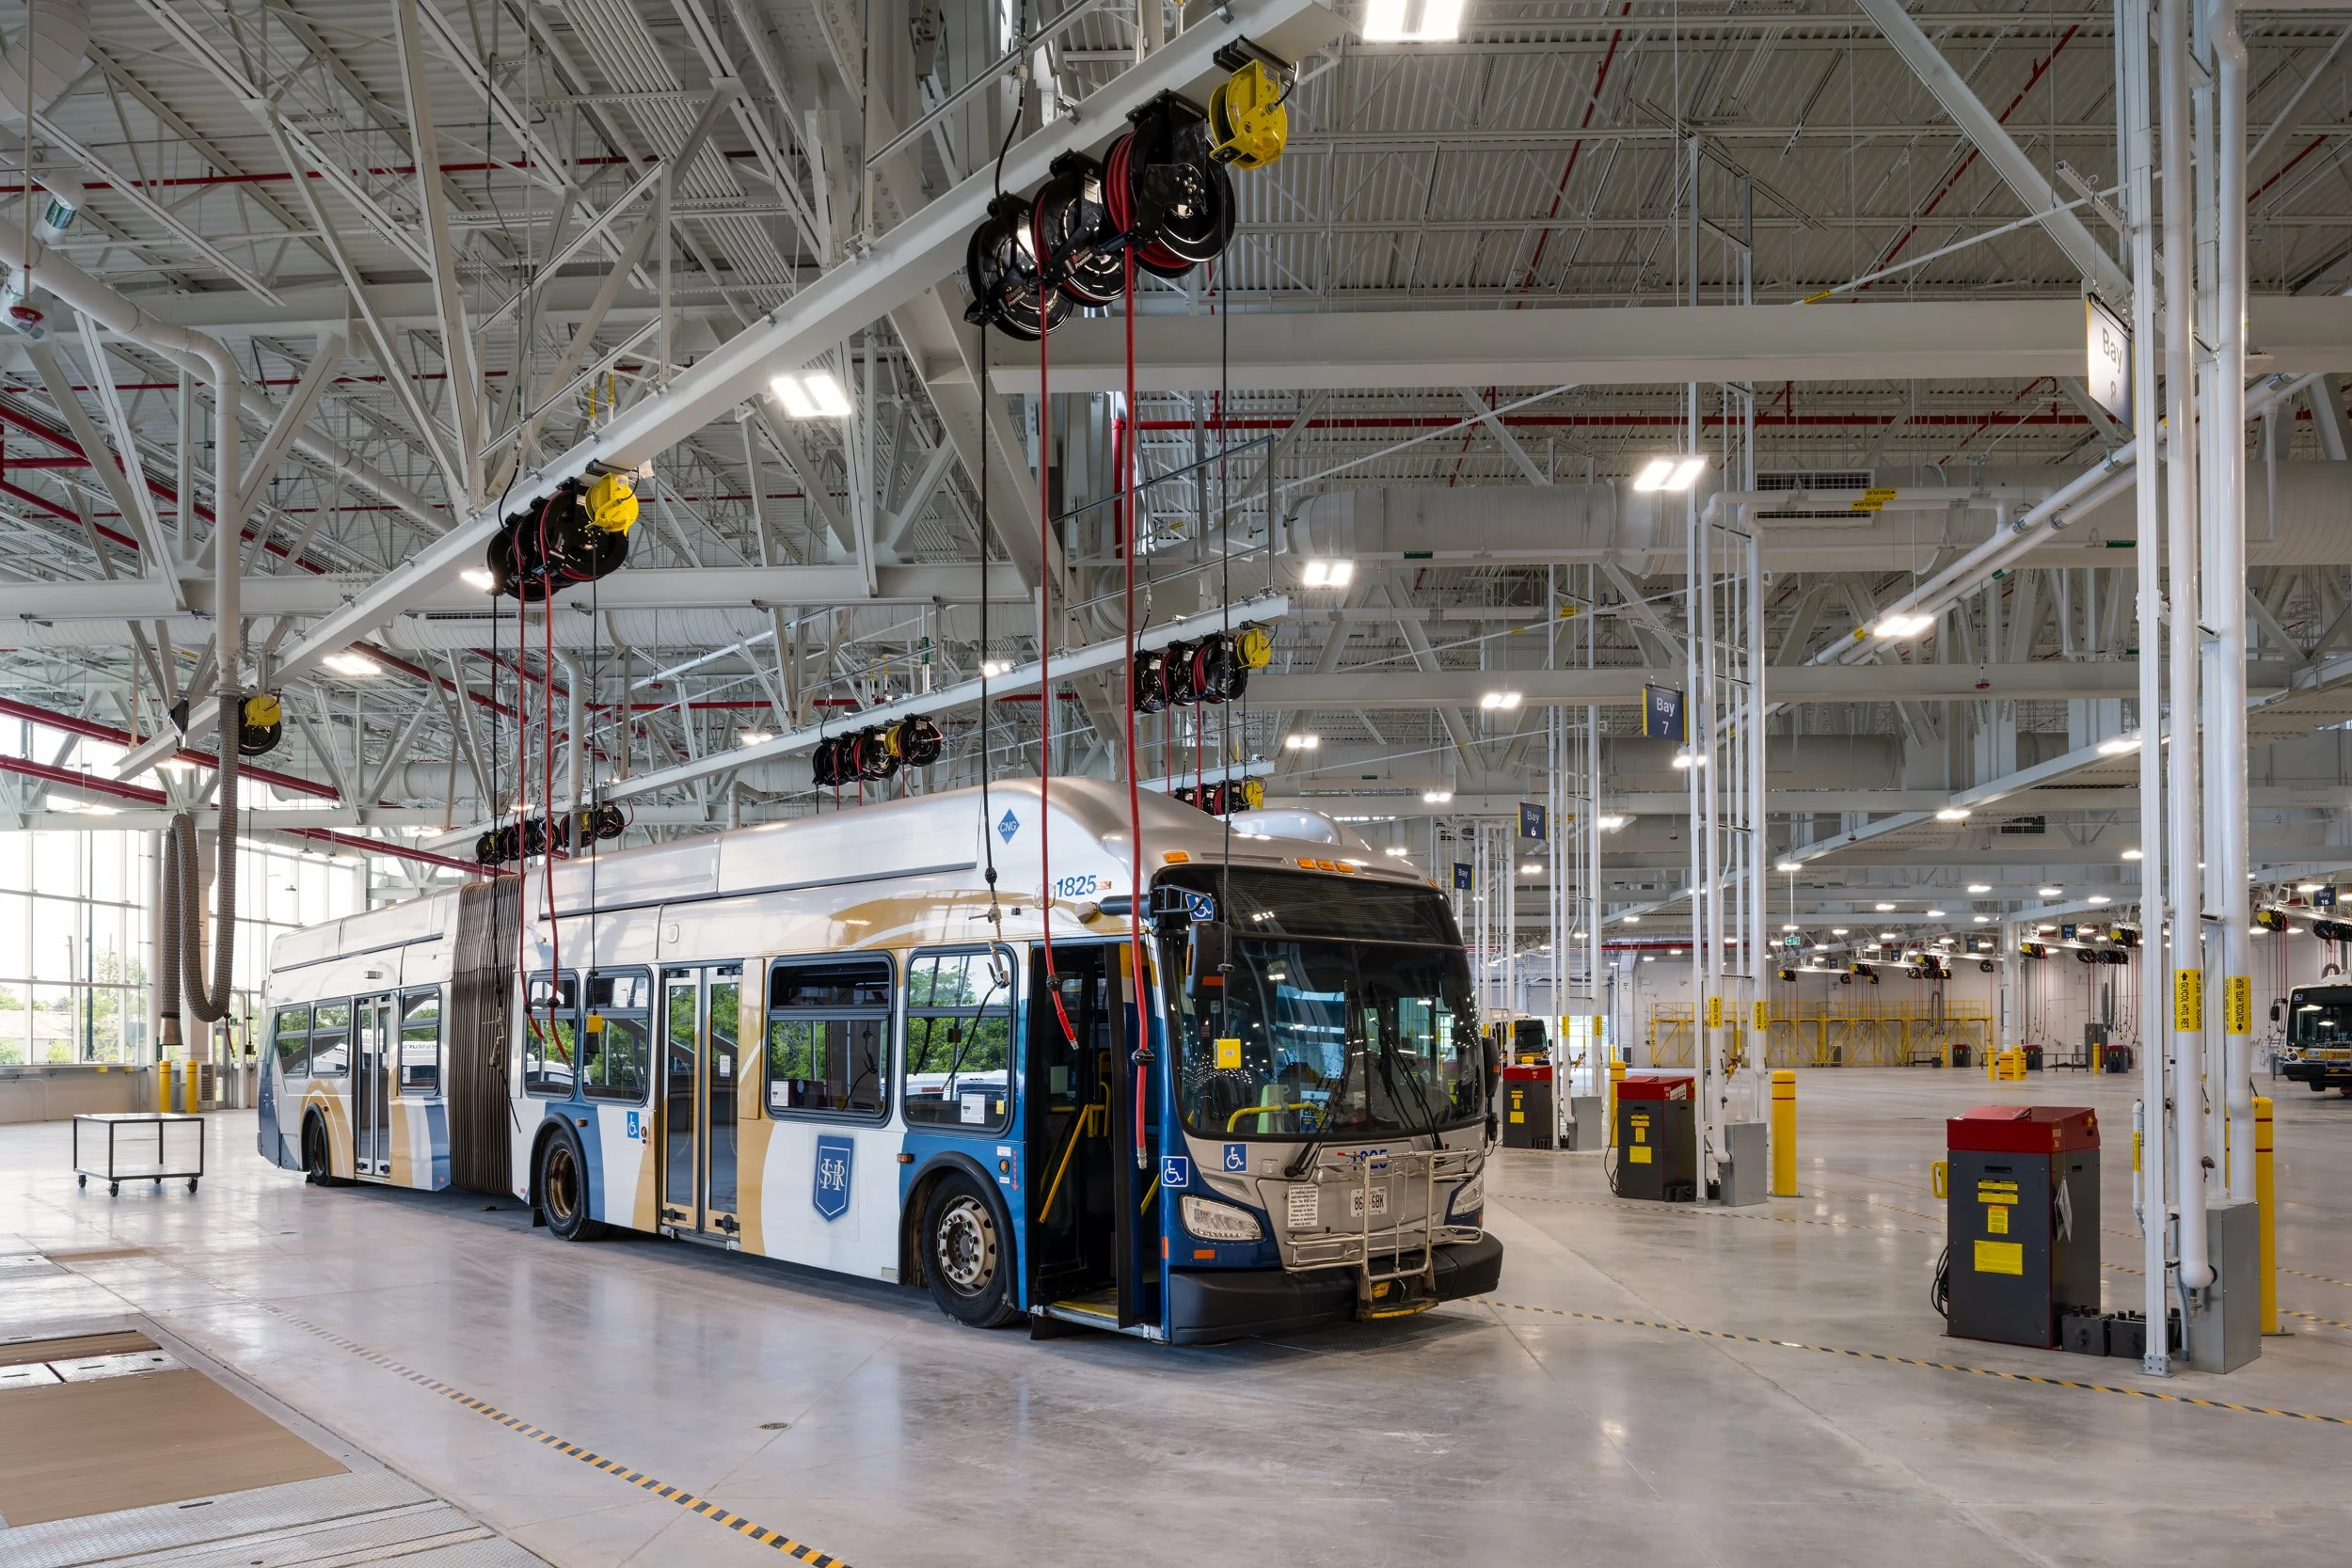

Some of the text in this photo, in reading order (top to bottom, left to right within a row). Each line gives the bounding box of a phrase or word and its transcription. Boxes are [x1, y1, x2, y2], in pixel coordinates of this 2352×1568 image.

[2102, 326, 2122, 374] Bay
[2110, 380, 2116, 406] 8
[1656, 697, 1675, 717] Bay
[1662, 721, 1669, 735] 7
[1000, 821, 1016, 832] CNG
[1527, 811, 1539, 824] Bay
[1531, 827, 1536, 836] 6
[1458, 868, 1468, 878] Bay
[1057, 875, 1096, 897] 1825
[2181, 982, 2189, 1029] GLYCOL HTG. RET.
[2236, 978, 2244, 1022] GLYCOL HTG. SUP.
